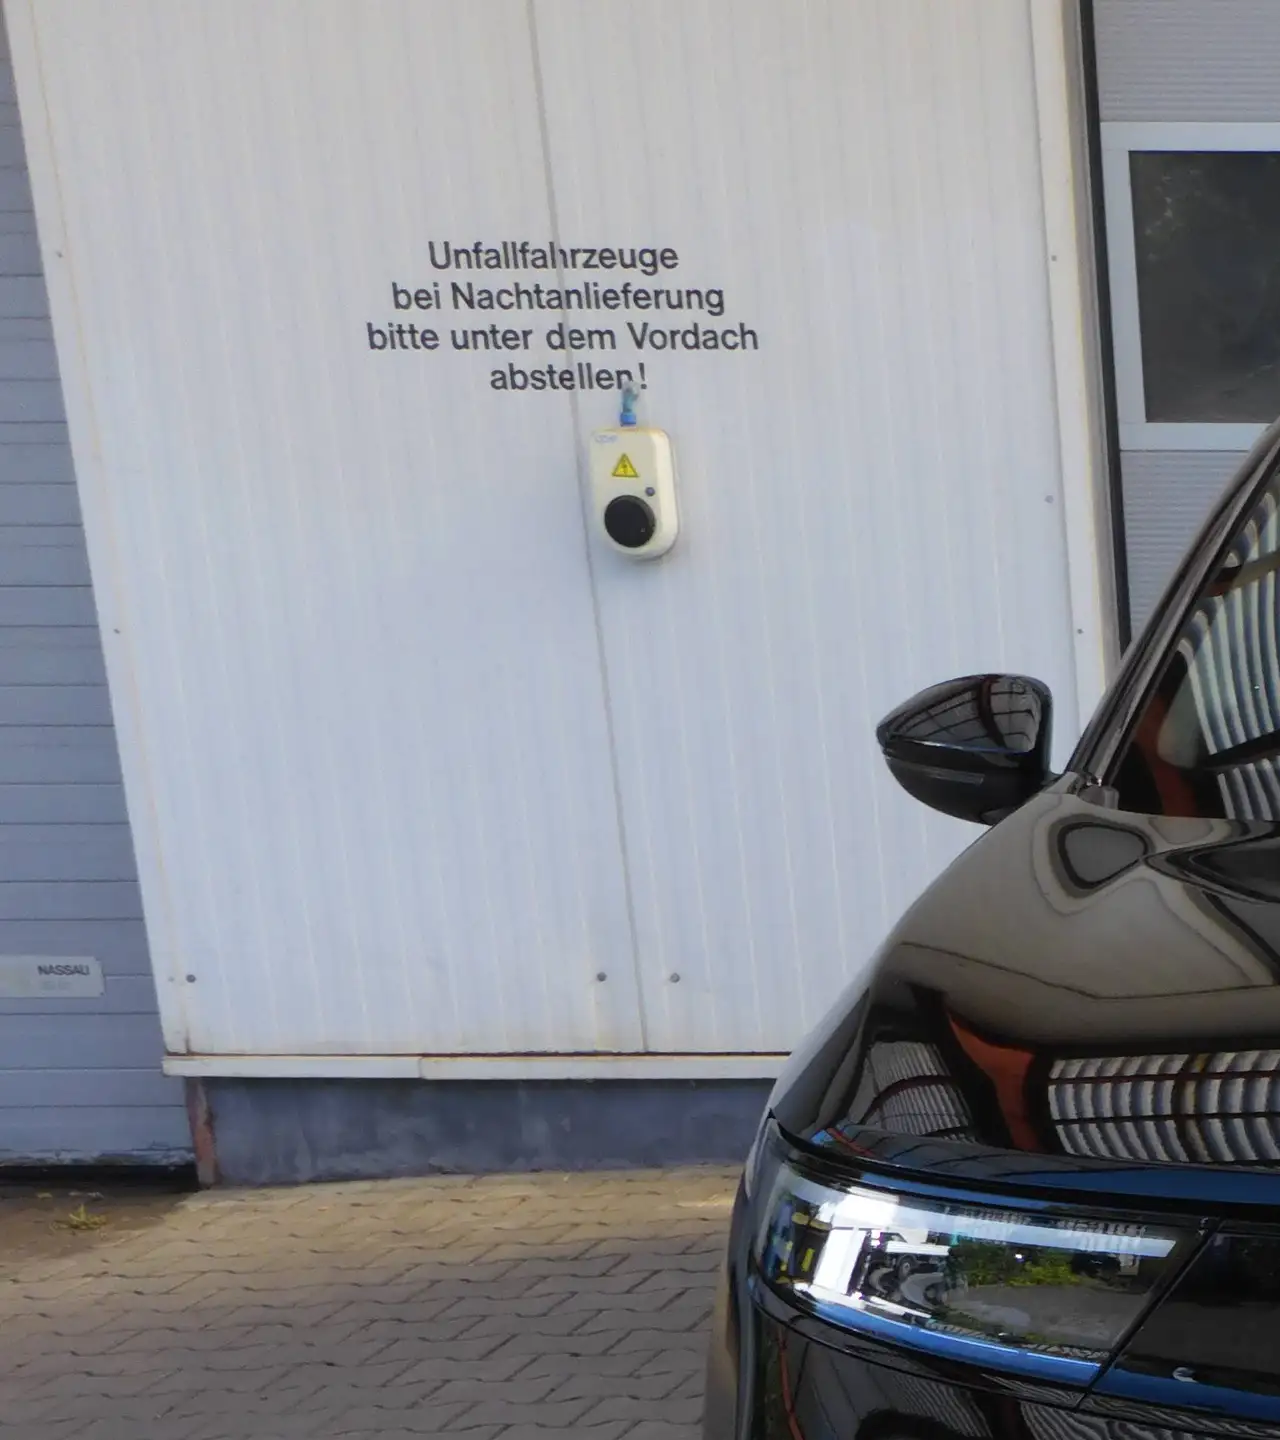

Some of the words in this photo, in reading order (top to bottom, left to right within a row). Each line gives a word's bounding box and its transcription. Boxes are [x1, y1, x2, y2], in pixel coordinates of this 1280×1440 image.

[427, 241, 679, 276] Unfallfahrzeuge
[391, 282, 441, 310] bei
[451, 282, 725, 316] Nachtanlieferung
[367, 322, 440, 351] bitte
[451, 323, 533, 351] unter
[546, 322, 616, 351] dem
[627, 322, 759, 351] Vordach
[490, 362, 647, 391] abstellen!
